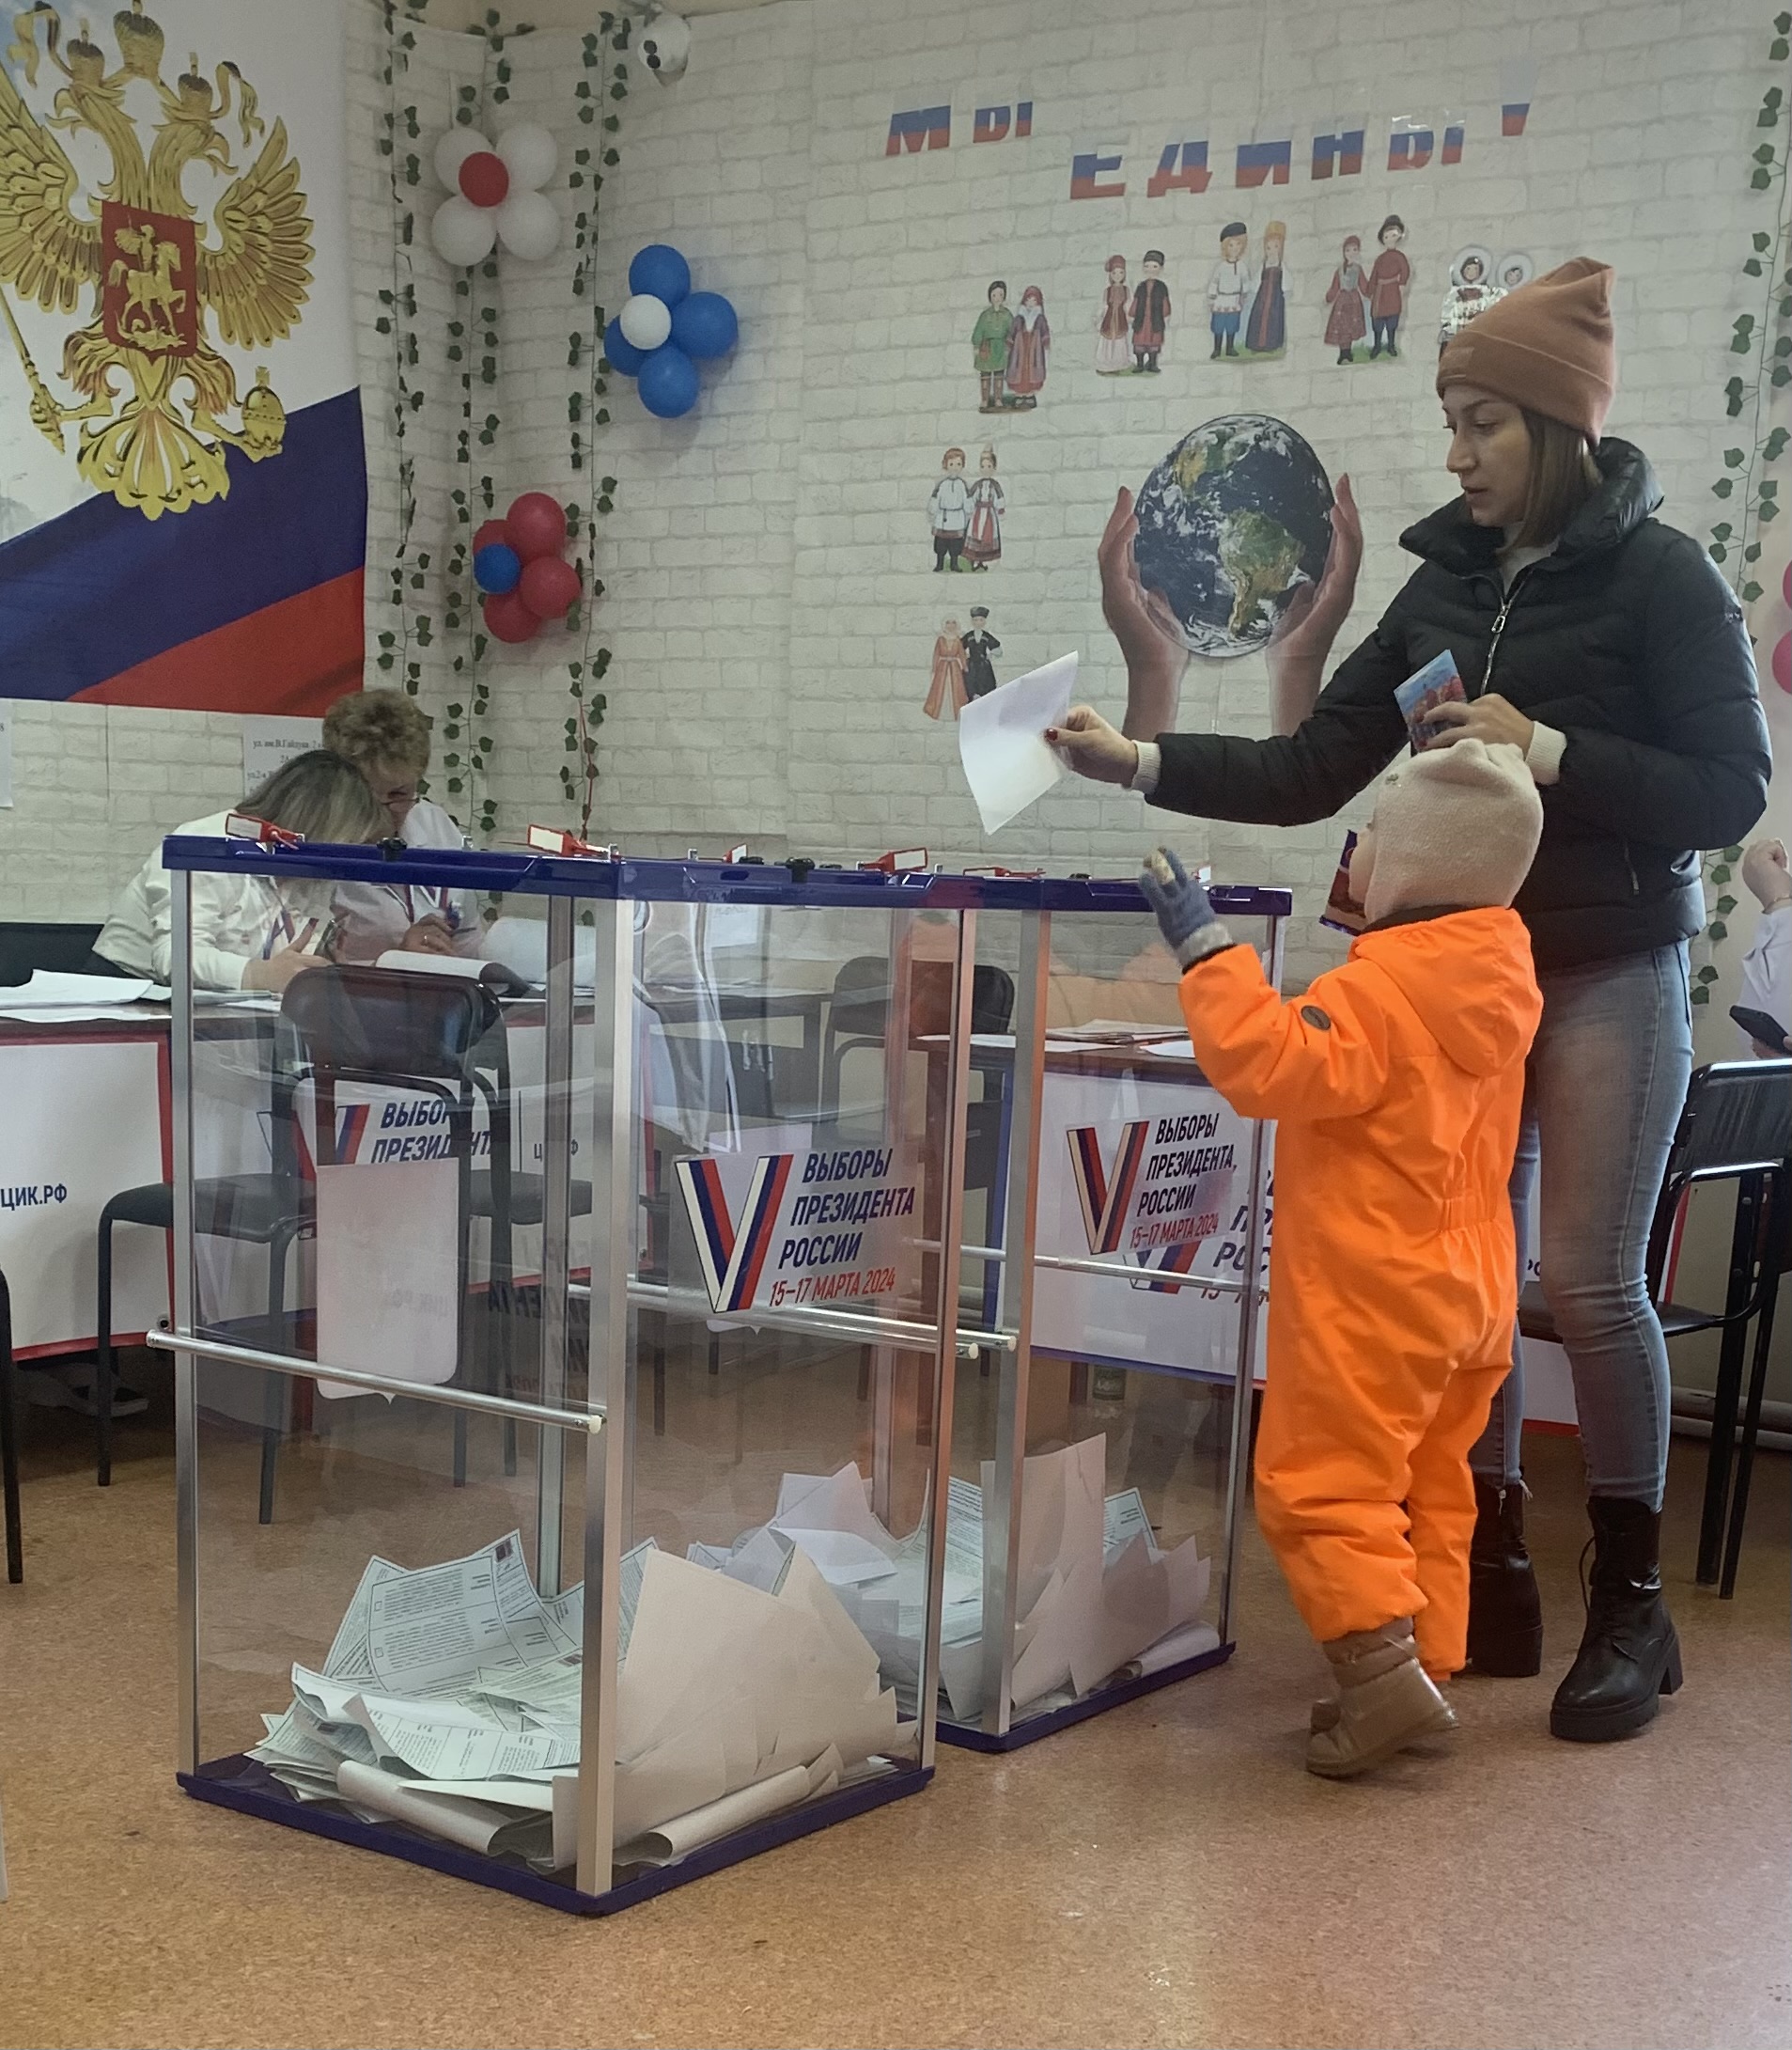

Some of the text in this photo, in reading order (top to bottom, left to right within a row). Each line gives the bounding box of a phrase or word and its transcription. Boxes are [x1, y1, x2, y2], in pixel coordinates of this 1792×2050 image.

[885, 80, 1034, 157] МЫ
[1155, 1112, 1220, 1146] ВЫБОРЫ
[802, 1148, 894, 1183] ВЫБОРЫ
[1, 1182, 68, 1212] ЦИК.РФ
[790, 1186, 915, 1227] ПРЕЗИДЕНТА
[1137, 1183, 1197, 1217] РОССИИ
[1160, 1216, 1195, 1244] МАРТА
[1194, 1213, 1220, 1237] 2024
[778, 1231, 864, 1270] РОССИИ
[811, 1271, 862, 1302] МАРТА
[861, 1266, 896, 1295] 2024
